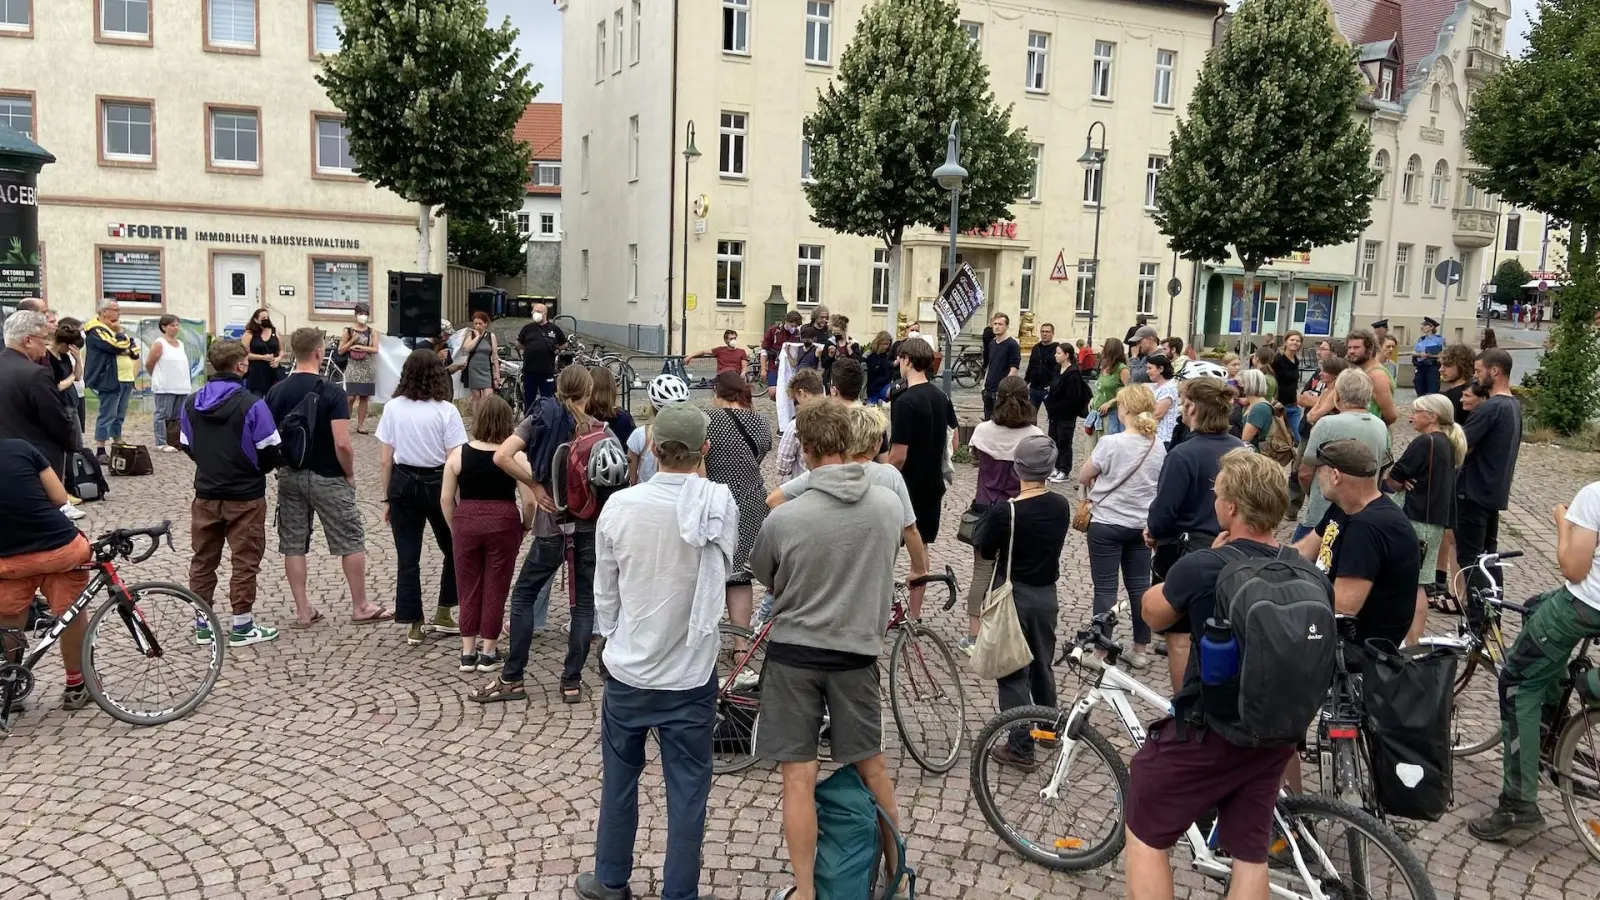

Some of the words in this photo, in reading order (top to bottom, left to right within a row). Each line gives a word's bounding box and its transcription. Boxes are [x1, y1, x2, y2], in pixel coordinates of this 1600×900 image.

[127, 224, 188, 240] FORTH
[195, 231, 259, 244] IMMOBILIEN
[261, 236, 268, 244] &
[270, 235, 360, 249] HAUSVERWALTUNG
